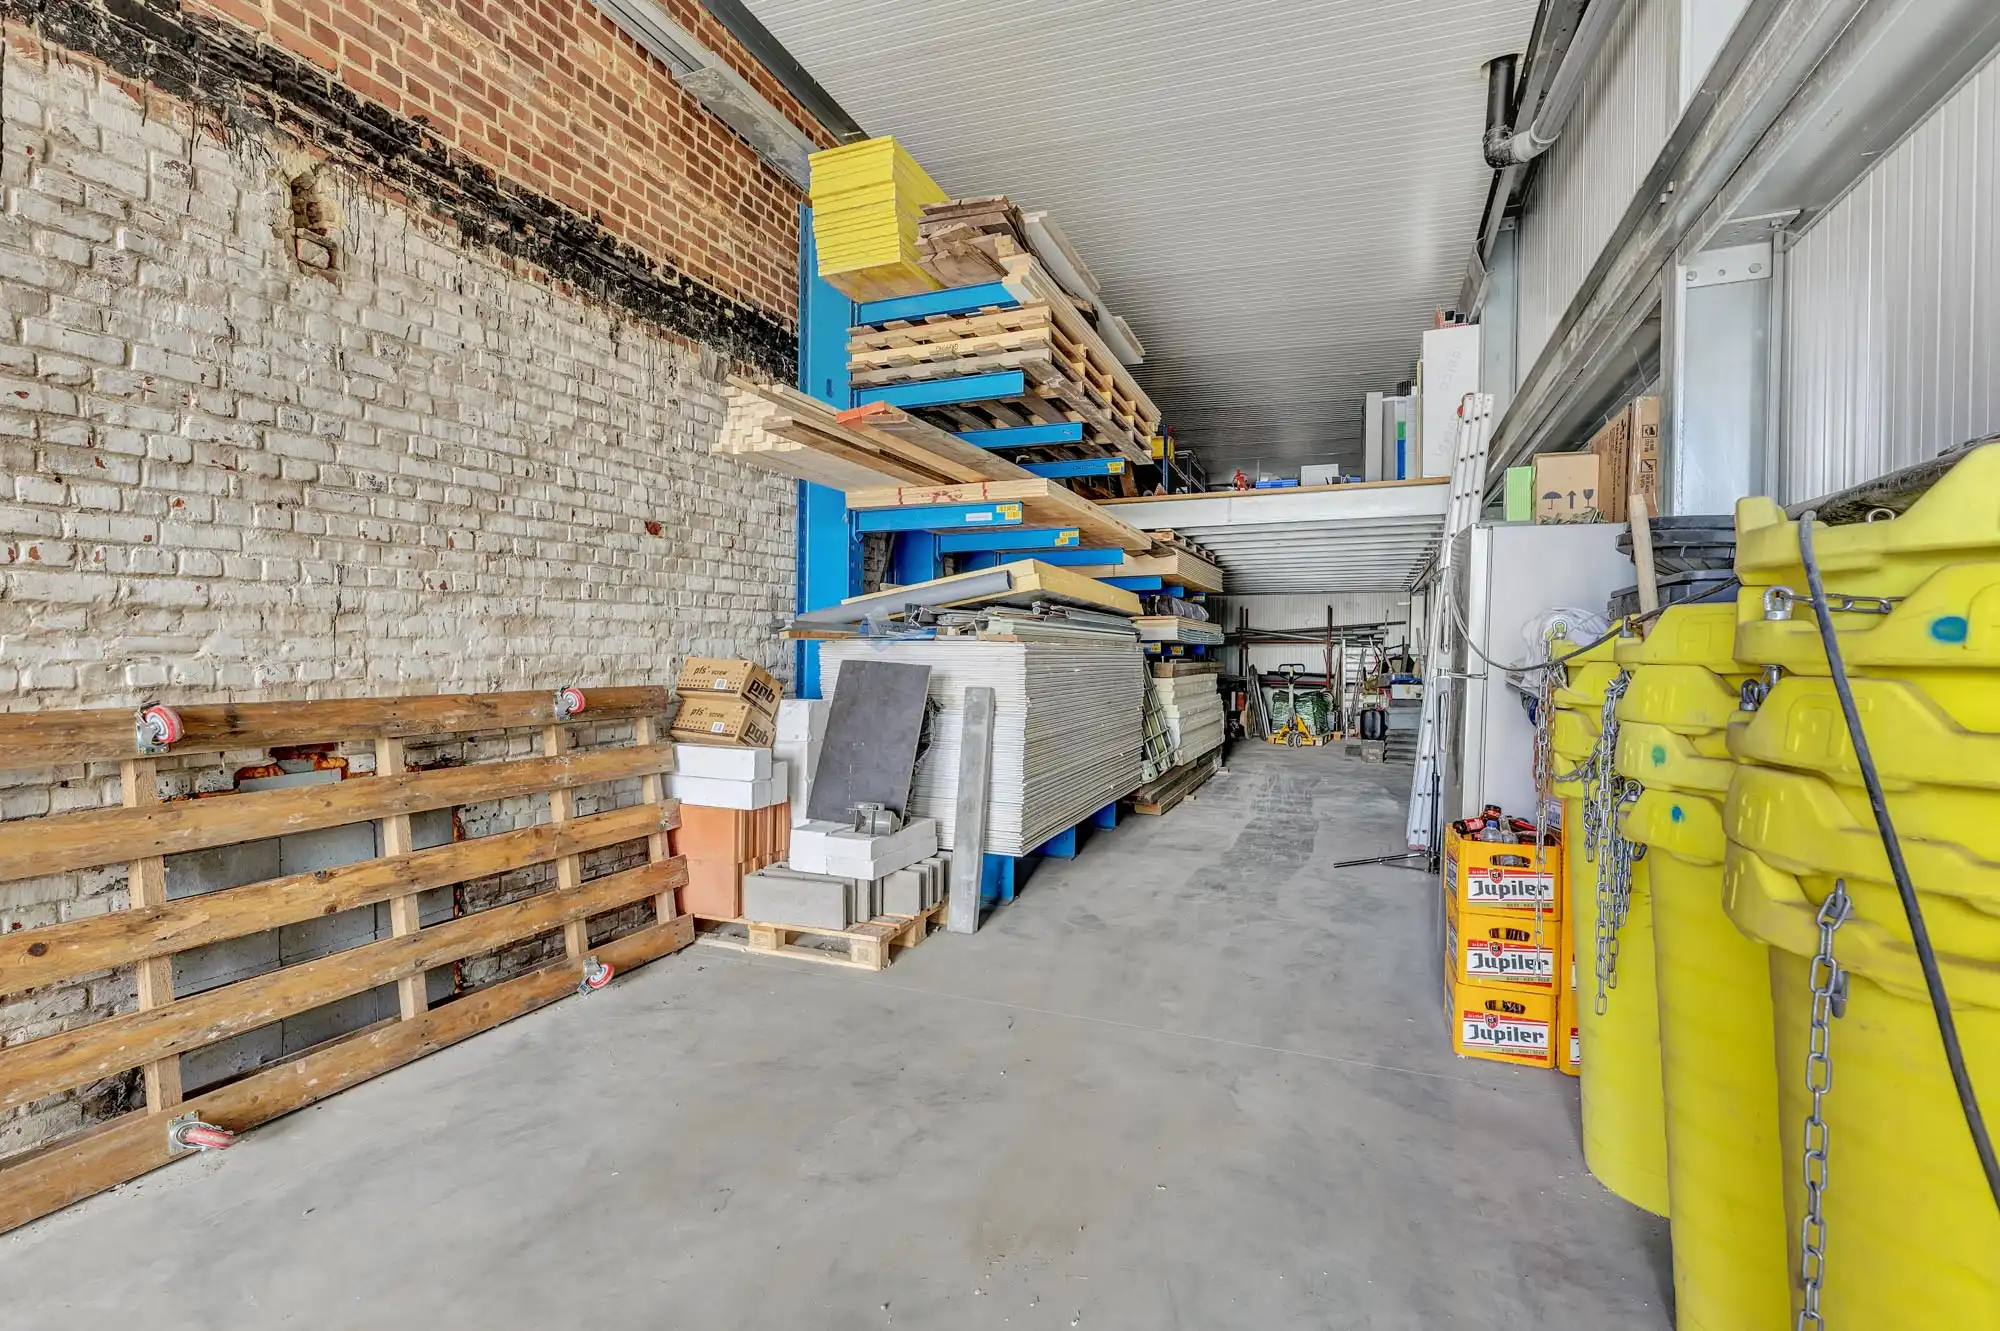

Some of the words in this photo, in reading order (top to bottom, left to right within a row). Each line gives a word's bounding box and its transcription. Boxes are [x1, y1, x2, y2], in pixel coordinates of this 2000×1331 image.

[744, 721, 769, 745] pgb
[1472, 880, 1549, 900] Jupiler
[1472, 952, 1549, 973] Jupiler
[1468, 1023, 1545, 1045] Jupiler
